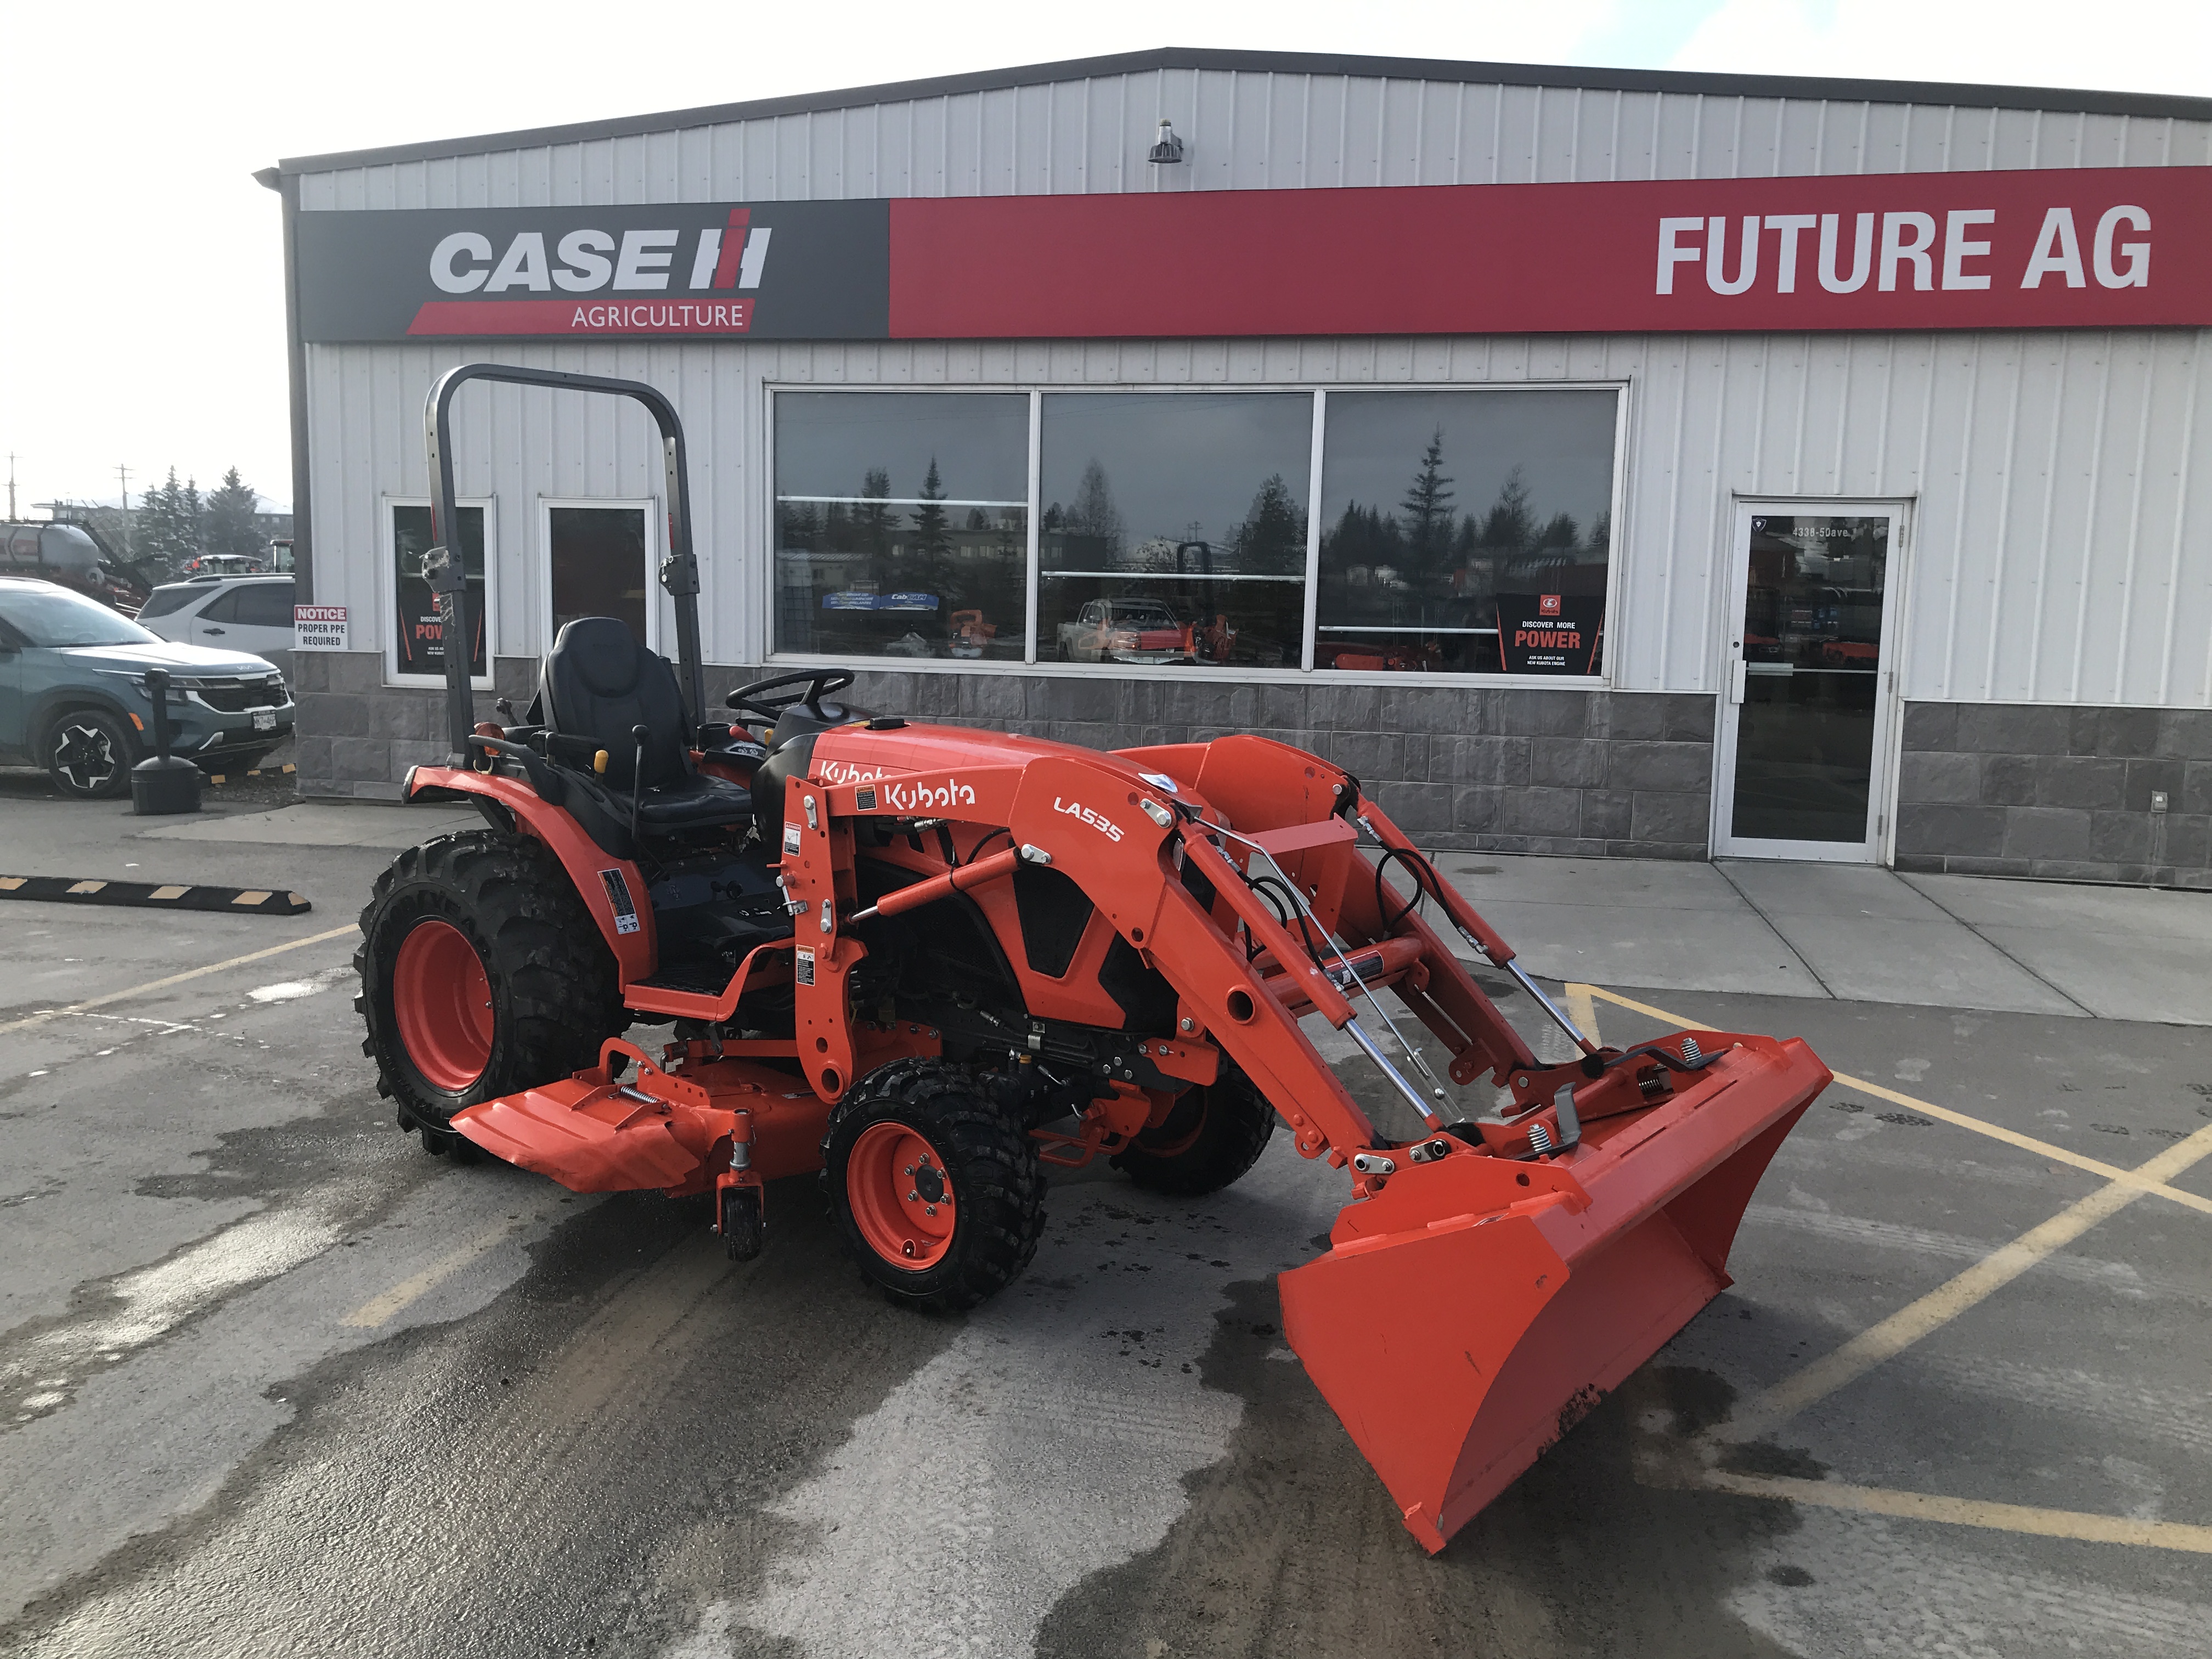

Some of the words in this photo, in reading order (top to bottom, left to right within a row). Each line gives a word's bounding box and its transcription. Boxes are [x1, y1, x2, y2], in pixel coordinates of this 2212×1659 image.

[429, 229, 680, 294] CASE
[689, 208, 772, 289] IH
[1656, 209, 1995, 295] FUTURE
[2020, 204, 2151, 289] AG
[571, 304, 743, 328] AGRICULTURE
[297, 608, 346, 620] NOTICE
[298, 624, 328, 633] PROPER
[330, 624, 345, 634] PPE
[303, 636, 340, 646] REQUIRED
[1515, 630, 1581, 648] POWER
[884, 778, 975, 810] Kubota
[1053, 796, 1125, 842] LA535
